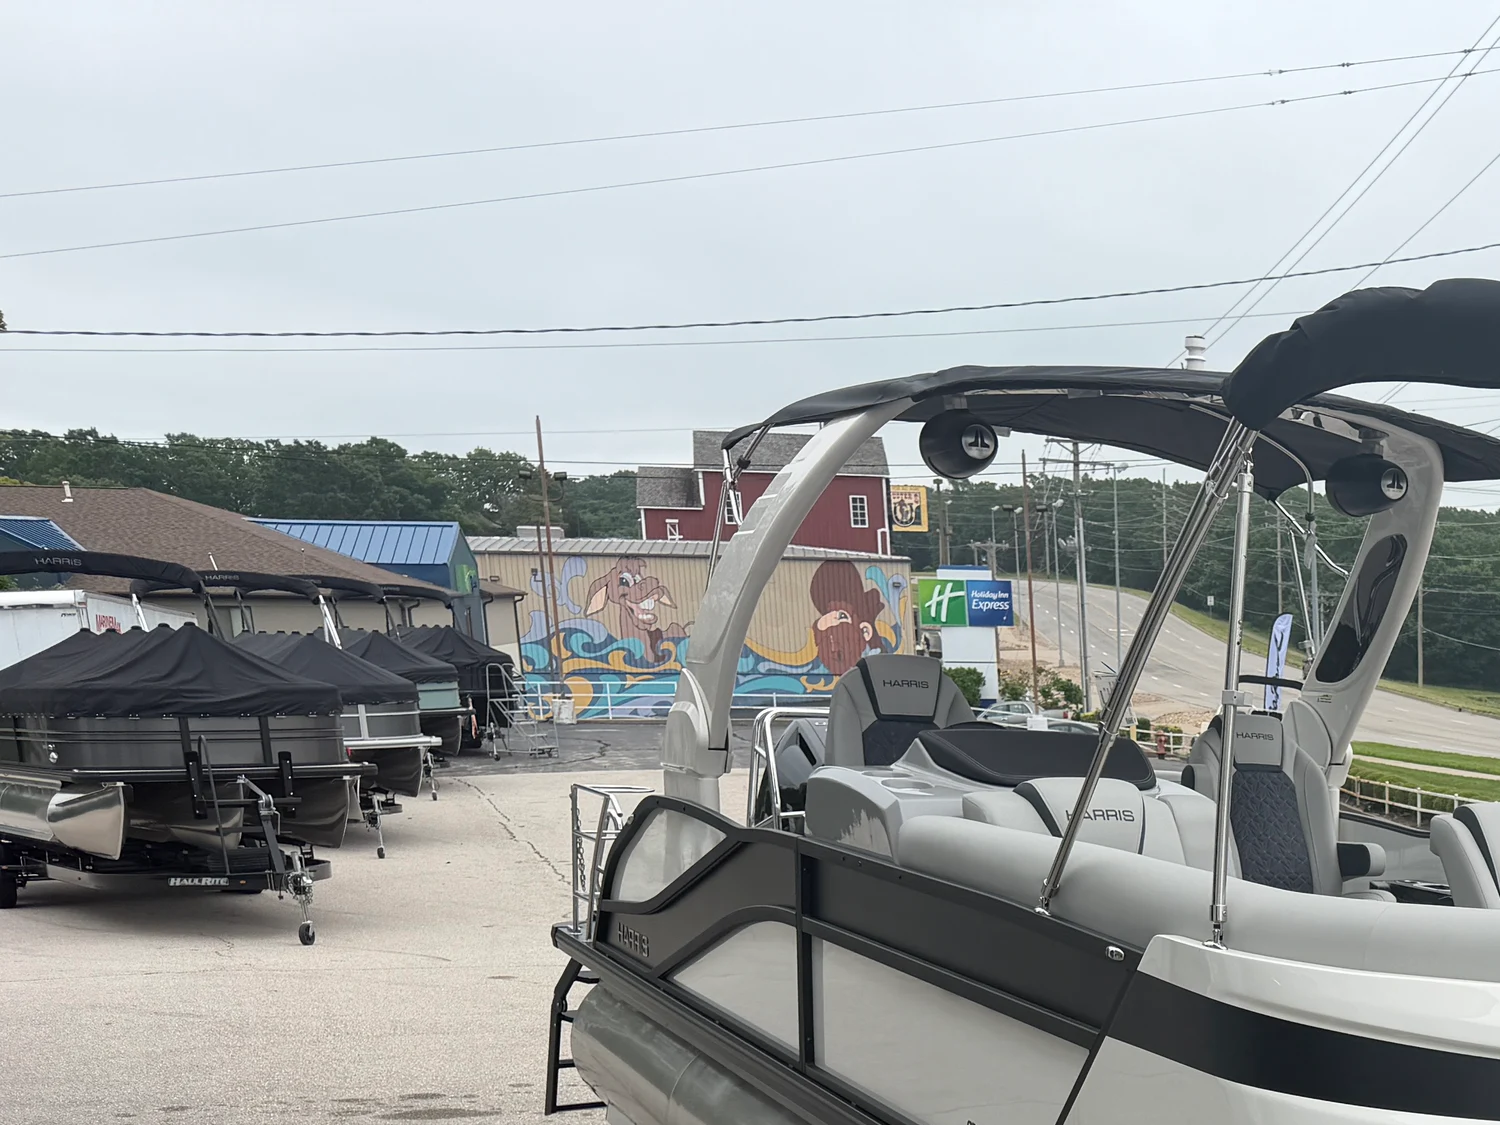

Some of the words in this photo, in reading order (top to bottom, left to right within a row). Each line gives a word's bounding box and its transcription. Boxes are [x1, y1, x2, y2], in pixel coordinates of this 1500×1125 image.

[34, 557, 82, 566] HARRIS
[971, 590, 997, 600] Holiday
[998, 590, 1009, 599] Inn
[971, 599, 1010, 612] Express
[882, 679, 930, 689] HARRIS
[1236, 731, 1274, 741] HARRIS
